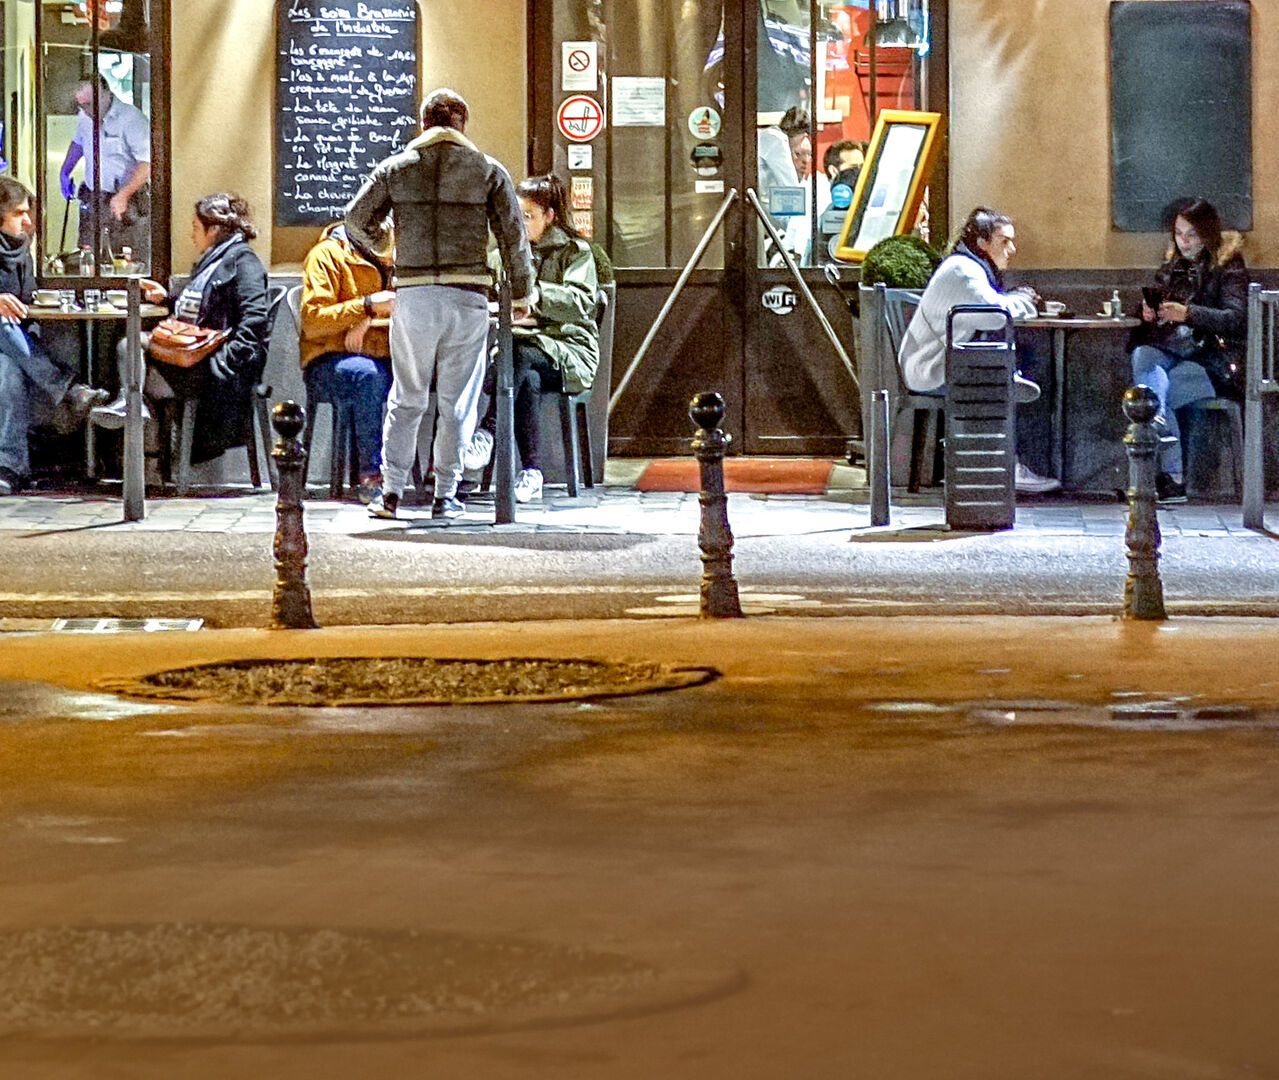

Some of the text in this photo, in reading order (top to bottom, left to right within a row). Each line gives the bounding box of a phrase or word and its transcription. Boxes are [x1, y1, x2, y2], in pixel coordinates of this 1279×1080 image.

[310, 20, 329, 32] de
[294, 97, 313, 112] La
[345, 103, 362, 113] de
[292, 145, 305, 153] en
[317, 155, 358, 174] Magret
[295, 173, 338, 182] canard
